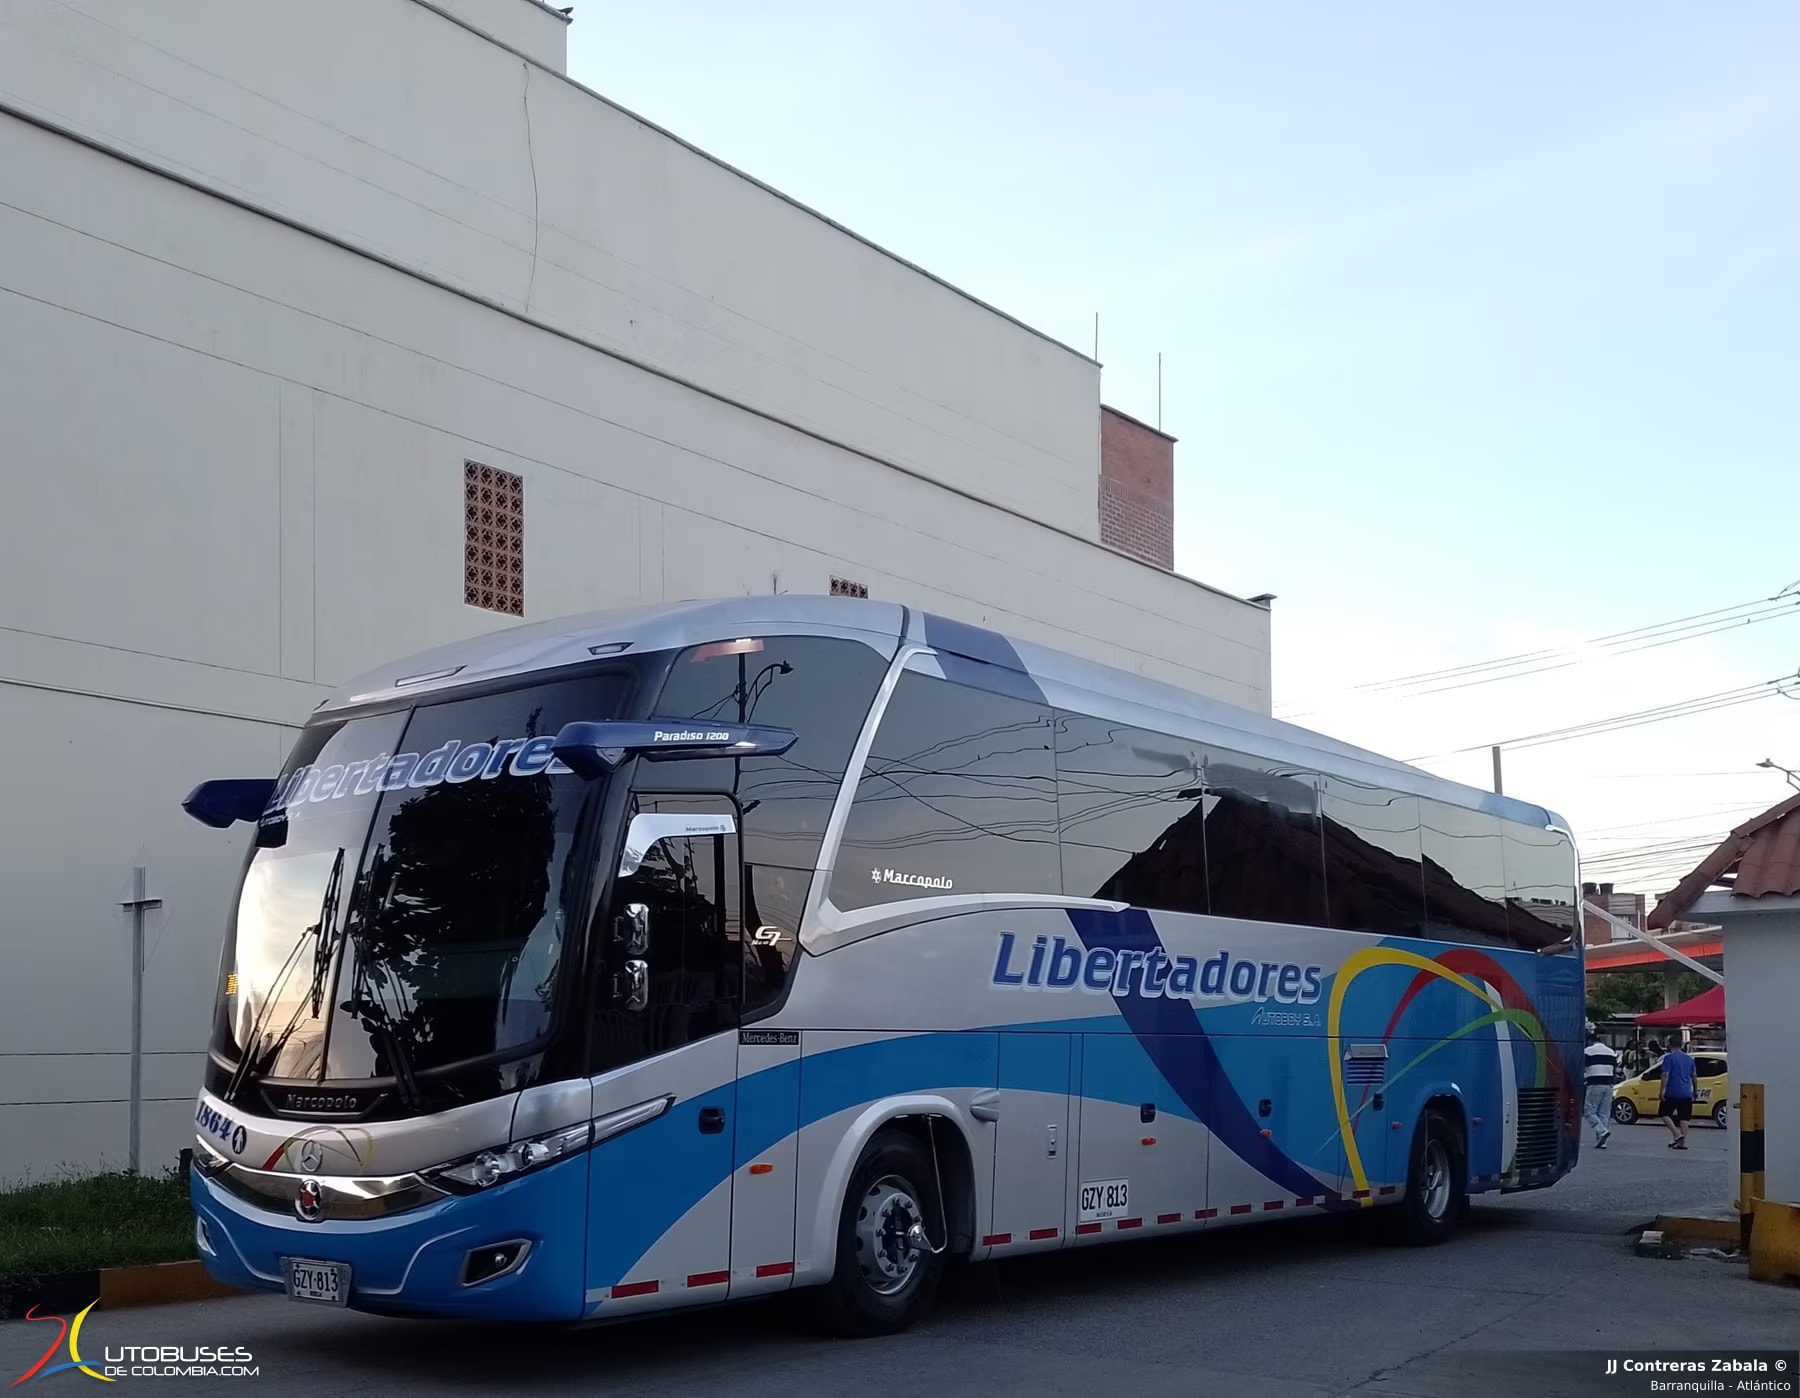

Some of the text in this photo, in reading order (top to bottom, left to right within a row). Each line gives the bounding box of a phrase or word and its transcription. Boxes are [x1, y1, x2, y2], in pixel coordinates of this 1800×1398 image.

[653, 730, 730, 742] Paradiso 1200
[261, 735, 576, 817] Libertadore
[883, 868, 953, 889] Marcopolo
[989, 930, 1323, 1004] Libertadores
[741, 1032, 798, 1044] Mercedes-Benz
[285, 1094, 358, 1110] Marcopolo
[1081, 1183, 1128, 1211] GZY 813
